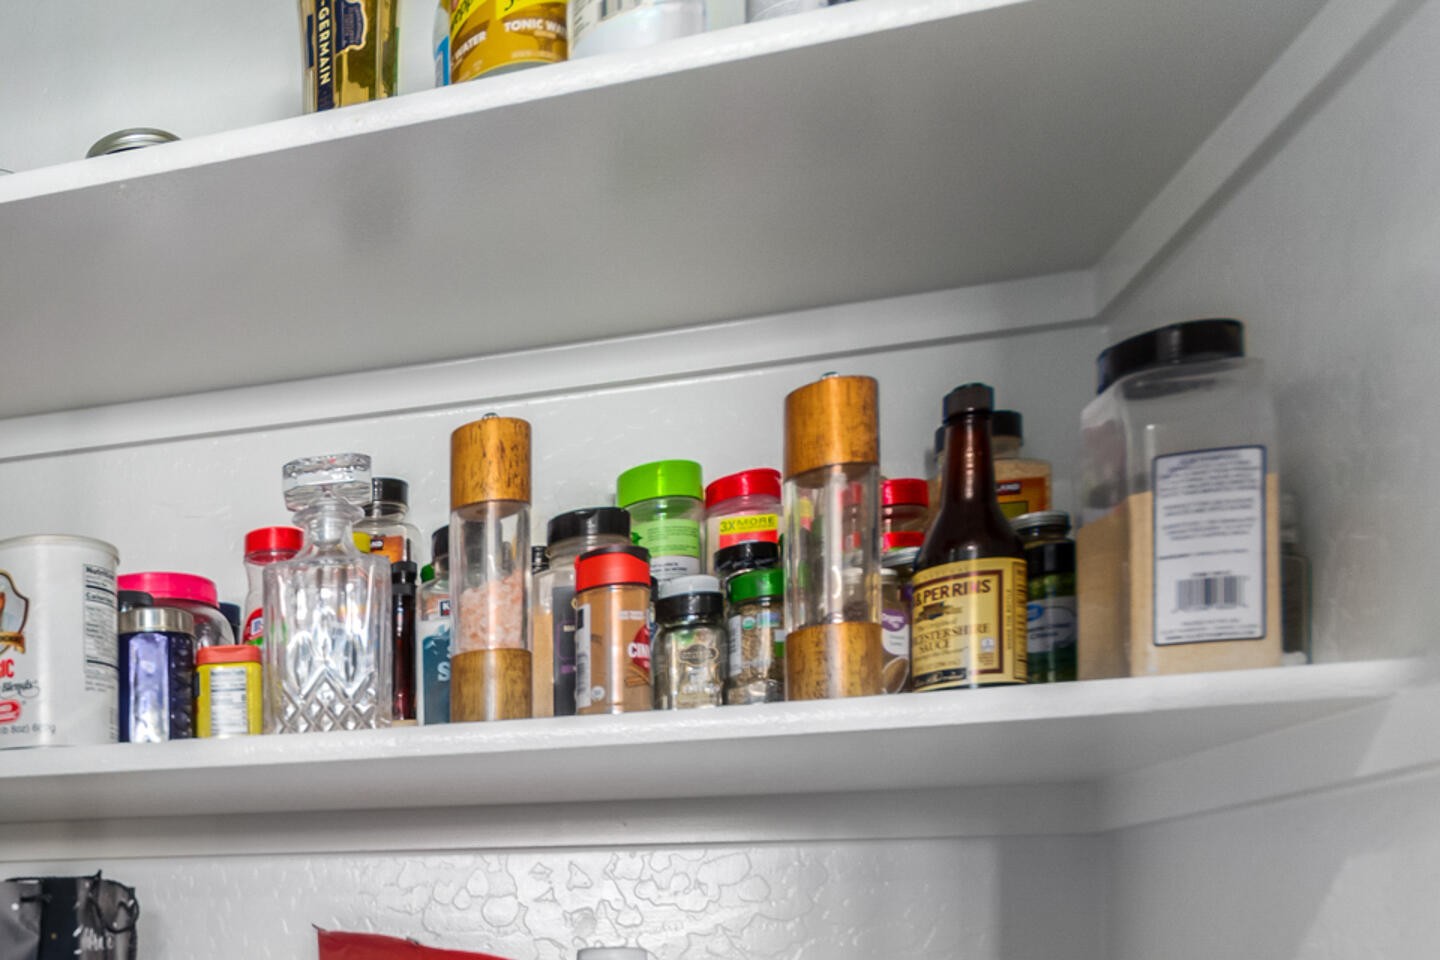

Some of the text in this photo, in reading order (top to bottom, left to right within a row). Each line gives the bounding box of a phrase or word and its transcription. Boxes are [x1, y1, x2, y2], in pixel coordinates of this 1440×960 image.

[504, 18, 544, 32] TONIC
[720, 515, 777, 533] 3X MORE
[923, 578, 992, 602] PERRINS
